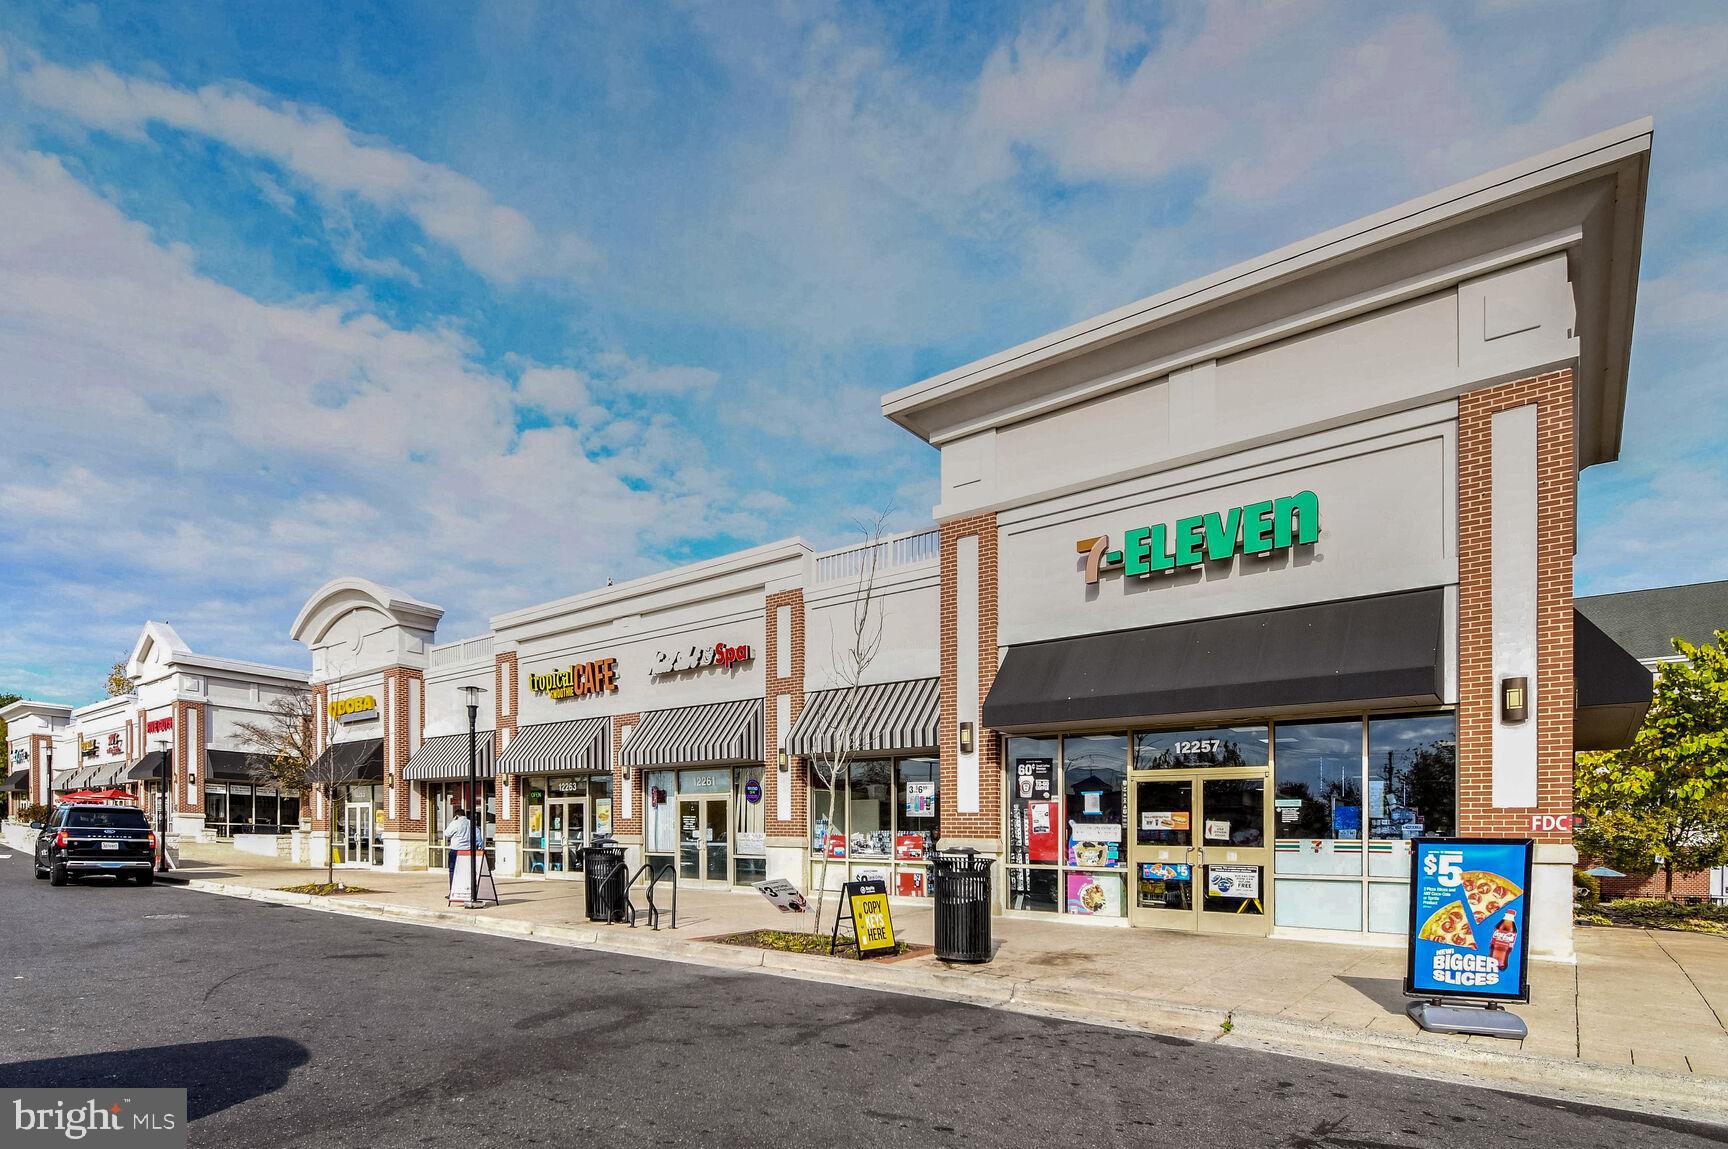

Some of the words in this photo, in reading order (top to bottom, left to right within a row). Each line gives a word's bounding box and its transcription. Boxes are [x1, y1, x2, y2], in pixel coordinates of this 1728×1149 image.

[715, 643, 748, 668] Spa
[529, 665, 574, 692] tropical
[574, 658, 616, 696] CAFE
[1175, 740, 1220, 753] 12257
[559, 783, 577, 791] 12263
[694, 777, 715, 786] 12261
[1532, 815, 1568, 831] FDC
[1424, 854, 1463, 887] $5
[863, 901, 881, 914] COPY
[865, 914, 884, 928] KEYS
[867, 927, 887, 941] HERE
[1433, 953, 1499, 973] BIGGER
[1432, 969, 1500, 986] SLICES
